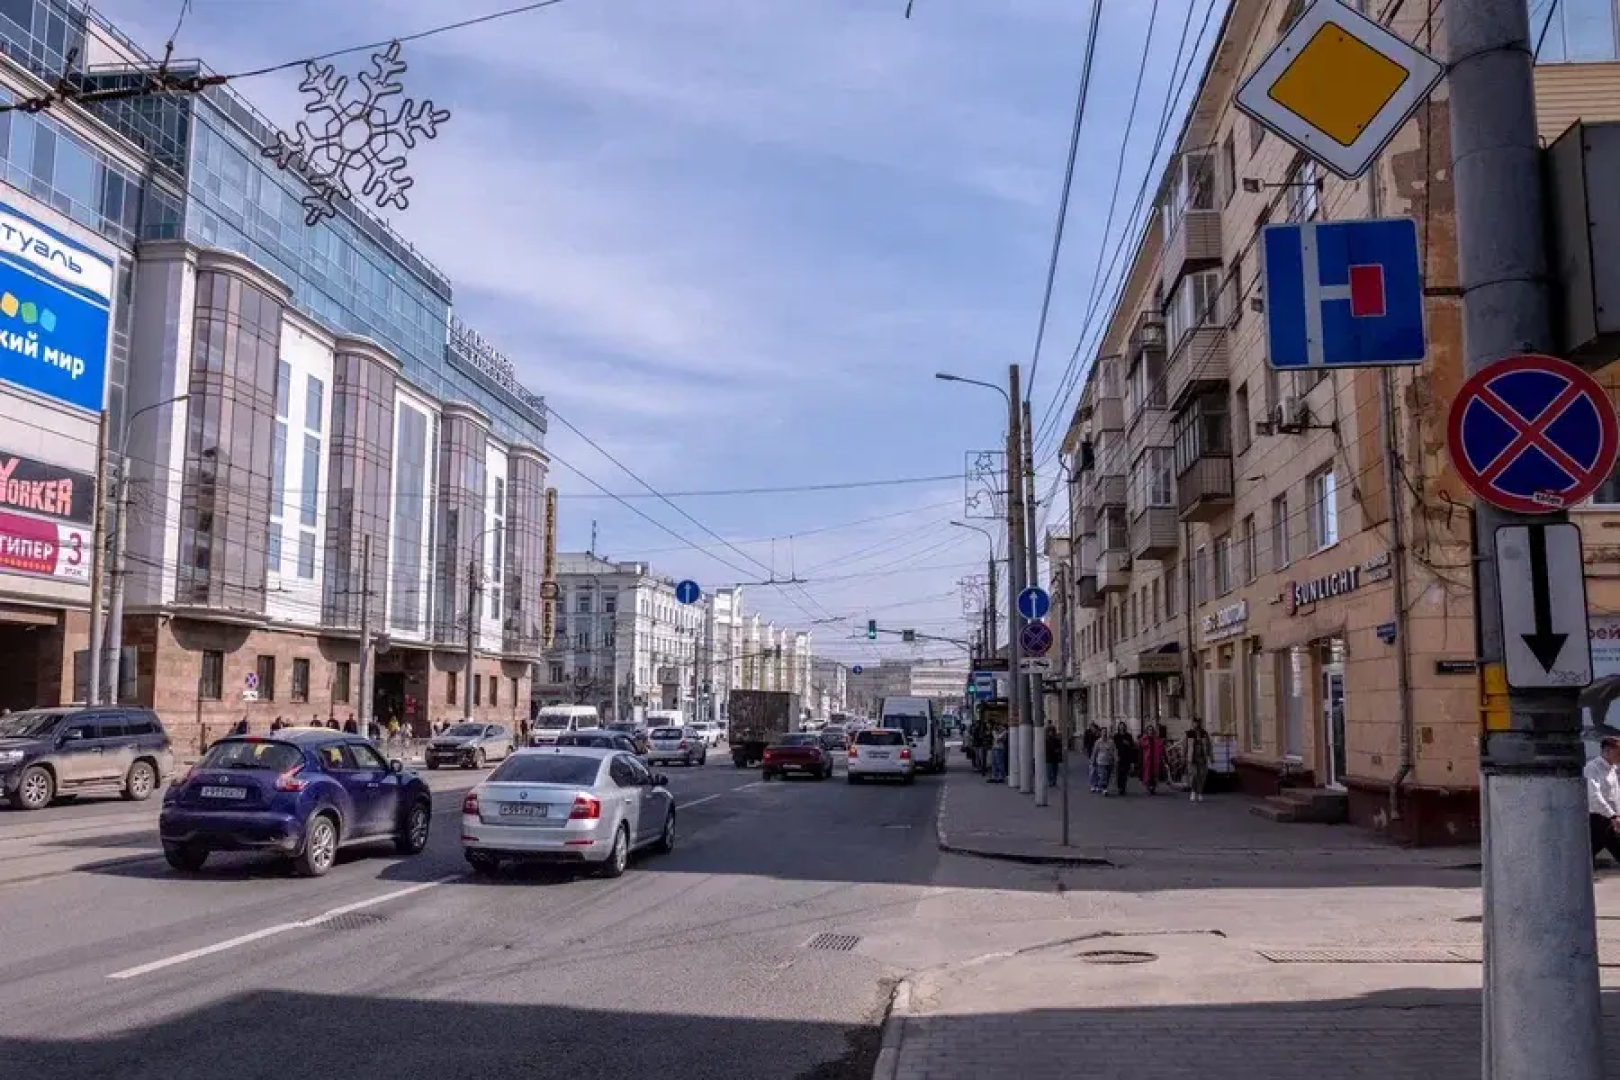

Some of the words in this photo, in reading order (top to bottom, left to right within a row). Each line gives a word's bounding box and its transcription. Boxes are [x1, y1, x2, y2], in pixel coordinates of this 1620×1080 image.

[43, 345, 86, 380] мир
[67, 532, 82, 565] 3
[1295, 566, 1358, 606] SUNLIGHT
